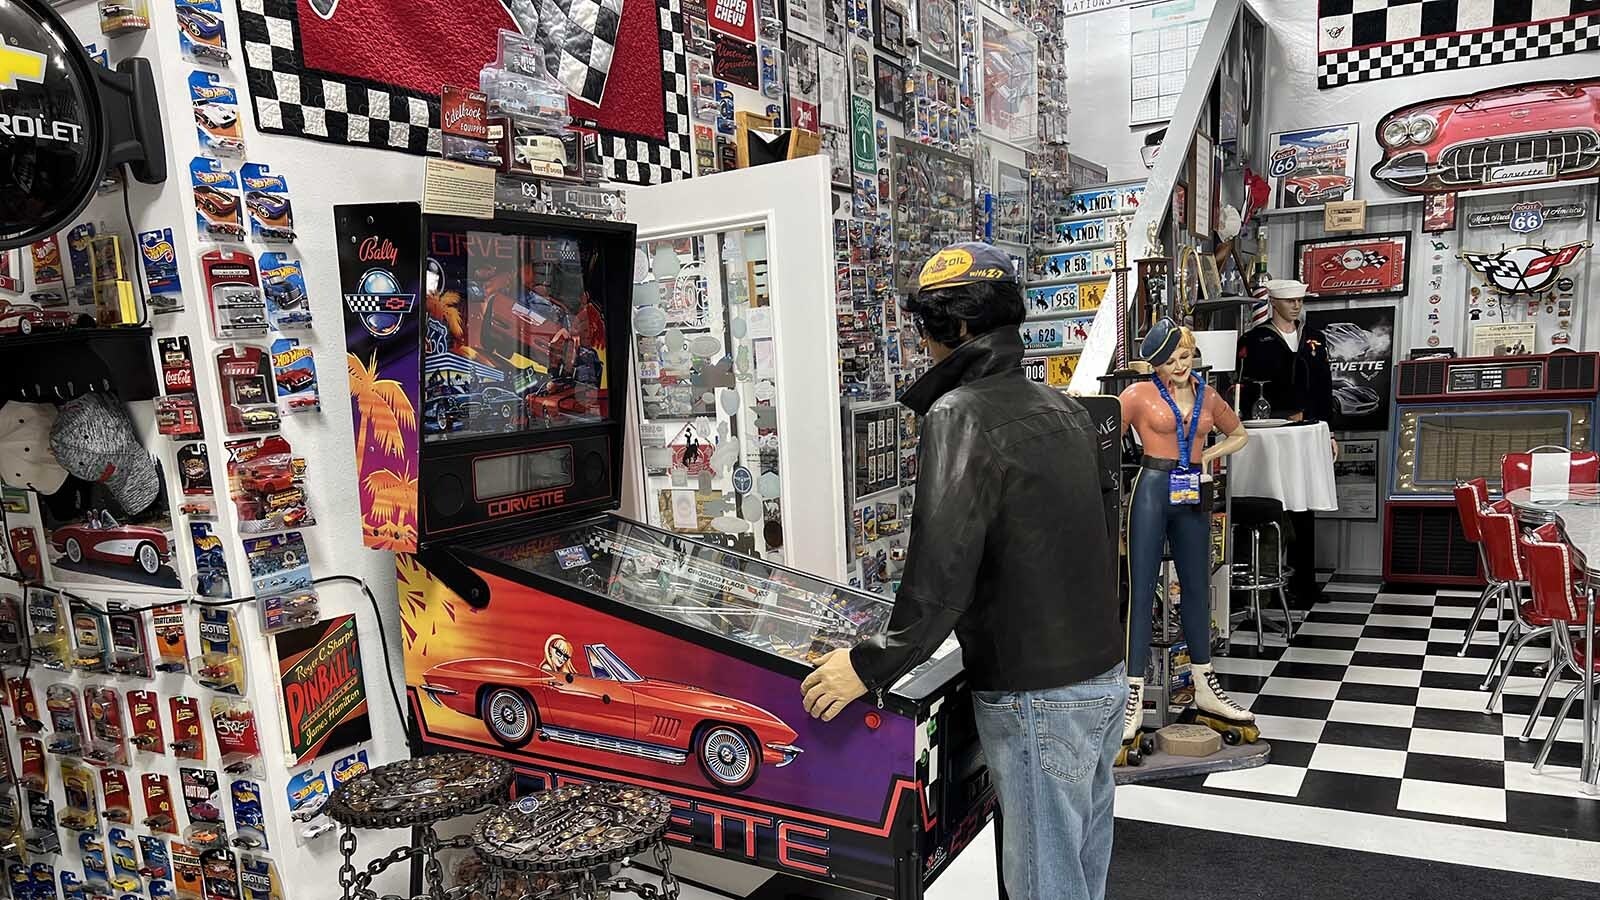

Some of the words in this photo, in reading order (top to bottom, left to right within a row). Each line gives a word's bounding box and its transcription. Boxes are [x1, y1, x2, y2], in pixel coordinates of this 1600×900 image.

[715, 5, 745, 27] CHEVY
[444, 102, 482, 129] Edelbrock
[797, 108, 812, 127] 2nd
[862, 133, 867, 153] 1
[1276, 158, 1295, 174] 66
[1491, 166, 1546, 180] Corvette
[1089, 195, 1113, 211] INDY
[1550, 206, 1582, 216] America
[1514, 215, 1538, 229] 66
[1075, 225, 1101, 241] INDY
[358, 236, 399, 267] Bally
[1074, 257, 1087, 272] 58
[1320, 275, 1381, 289] Corvette
[1050, 291, 1076, 308] 1958
[1038, 327, 1056, 343] 629
[487, 489, 564, 517] CORVETTE
